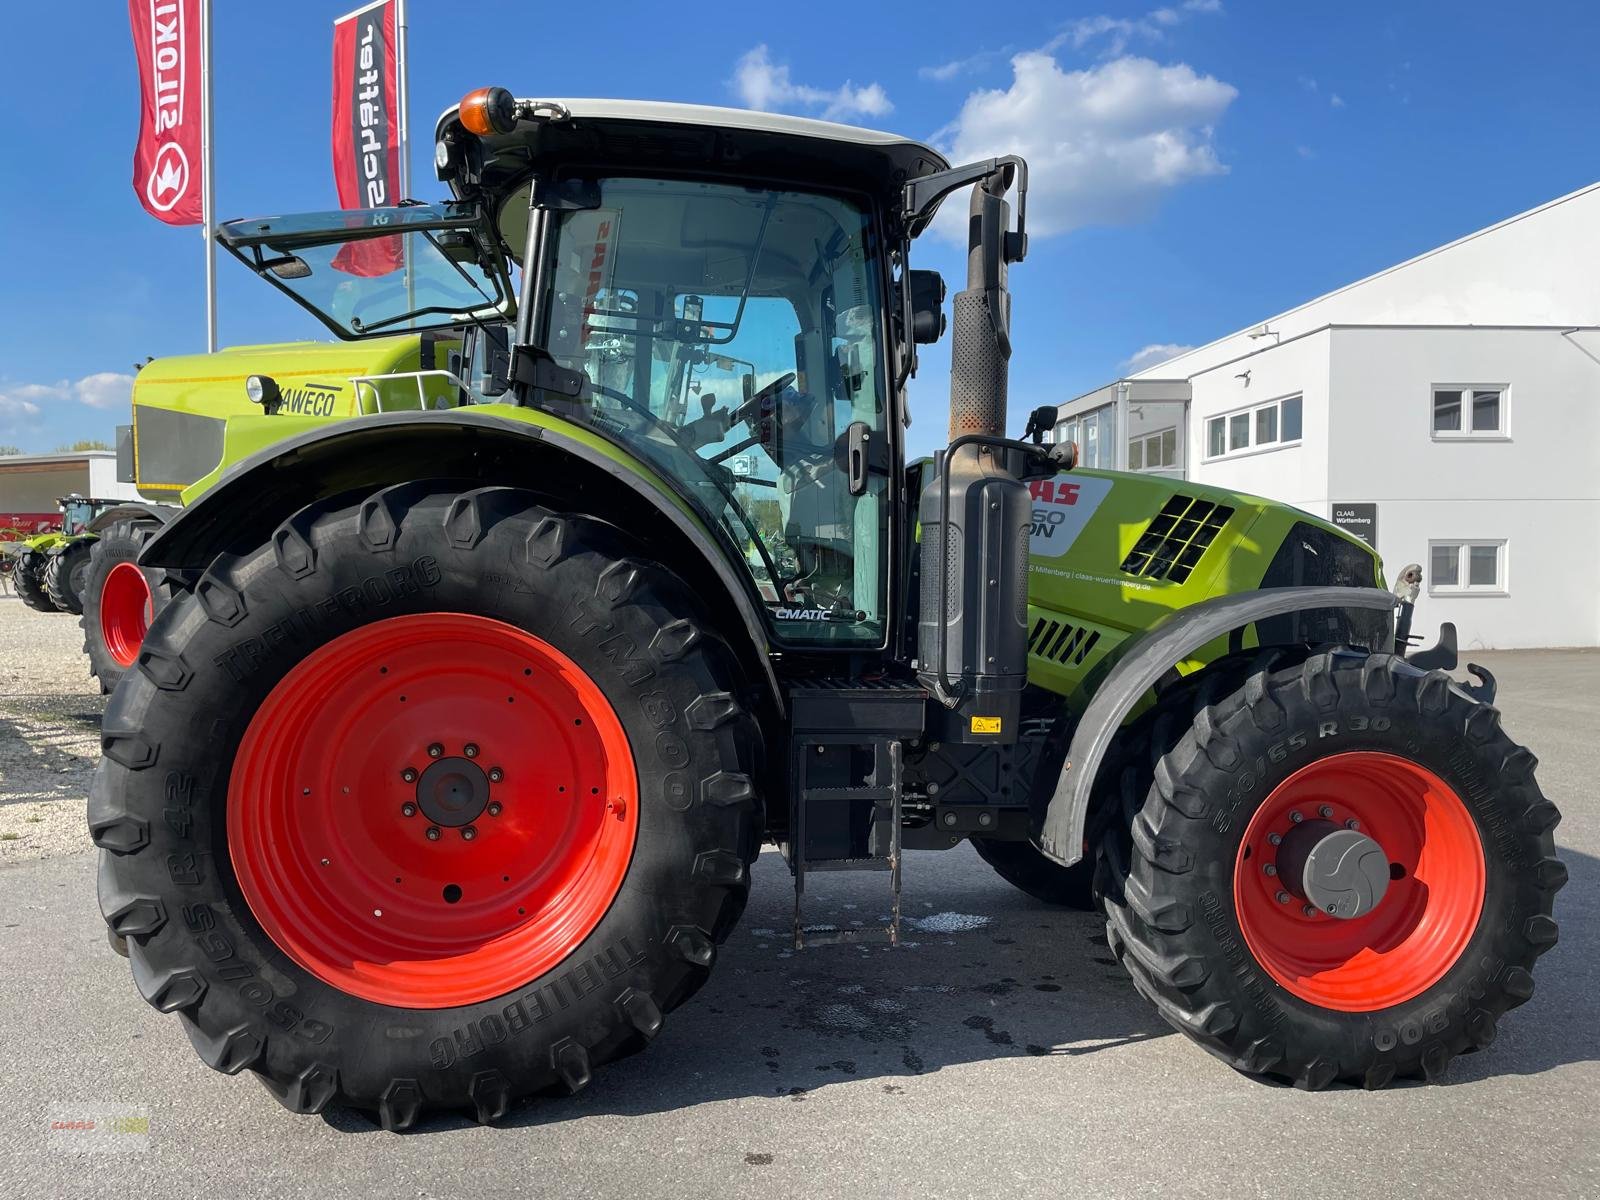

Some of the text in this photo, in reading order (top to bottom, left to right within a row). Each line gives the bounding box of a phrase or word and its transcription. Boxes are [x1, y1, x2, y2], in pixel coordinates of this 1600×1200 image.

[279, 387, 335, 416] AWECO
[1029, 480, 1081, 505] AS
[776, 609, 832, 620] CMATIC
[428, 936, 648, 1070] TRELLEBORG
